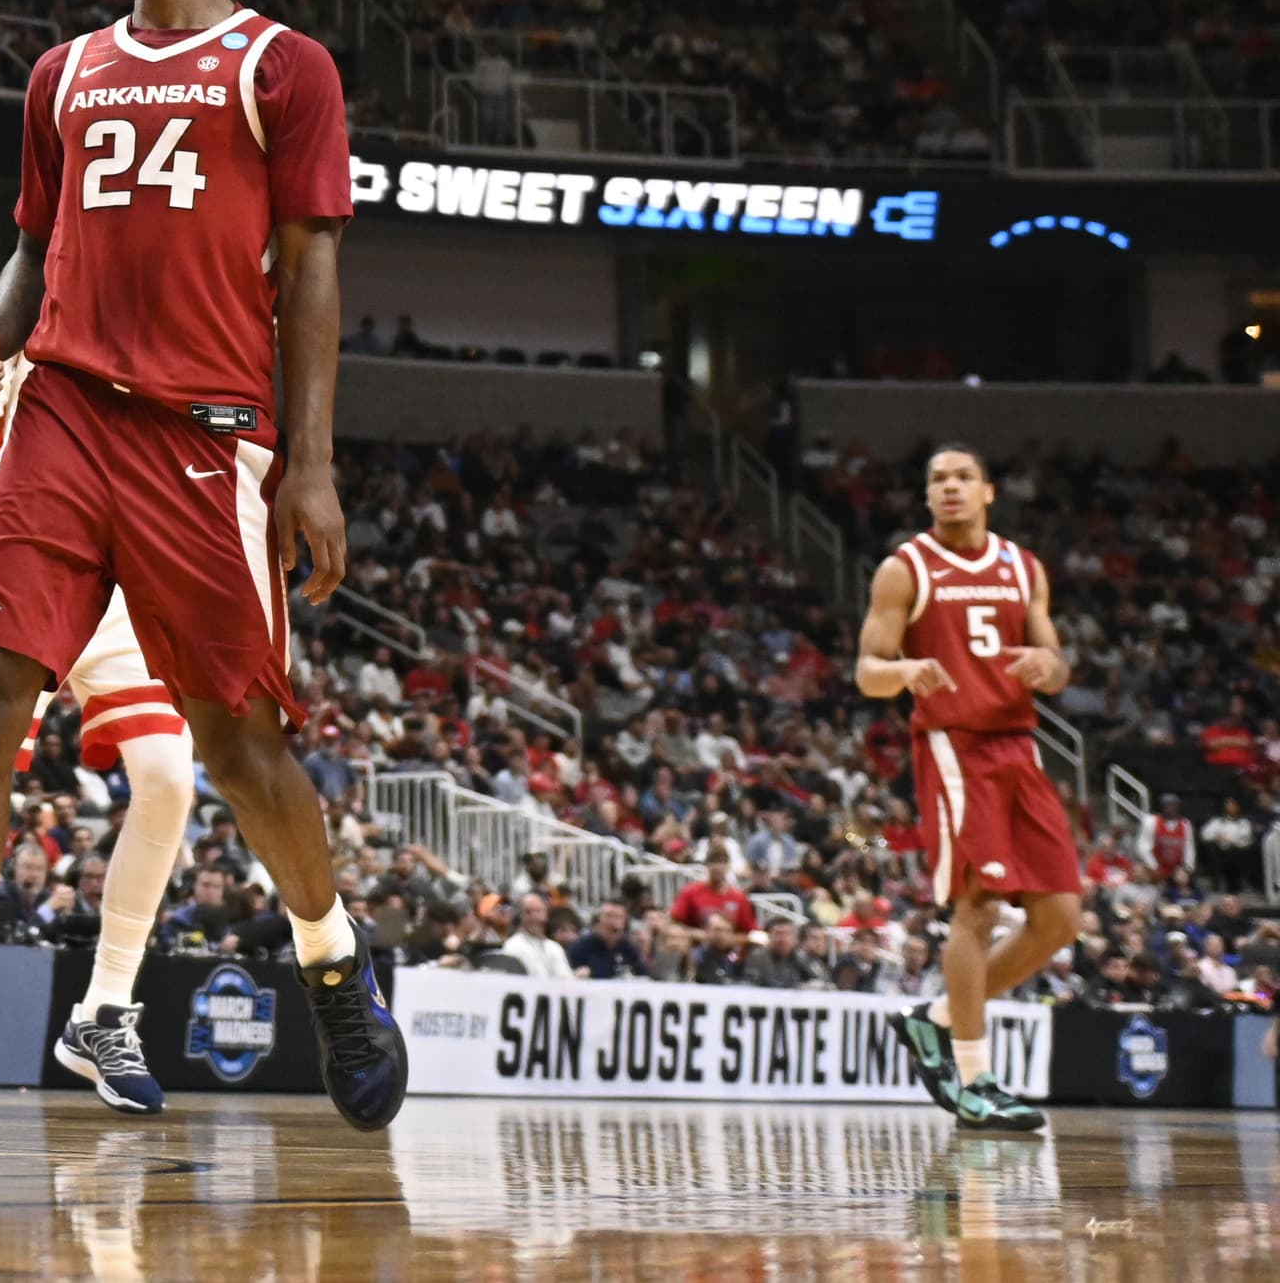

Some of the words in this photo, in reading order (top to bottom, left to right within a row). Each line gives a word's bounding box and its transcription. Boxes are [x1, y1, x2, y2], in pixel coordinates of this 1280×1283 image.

[69, 84, 227, 113] ARKANSAS
[83, 118, 207, 210] 24
[397, 161, 595, 225] SWEET
[598, 177, 862, 237] SIXTEEN
[966, 606, 1002, 658] 5
[411, 1010, 465, 1038] HOSTED
[468, 1013, 488, 1039] BY
[496, 992, 585, 1081] SAN
[597, 999, 707, 1083] JOSE
[720, 1004, 829, 1086] STATE
[842, 1009, 1039, 1088] UNIITY
